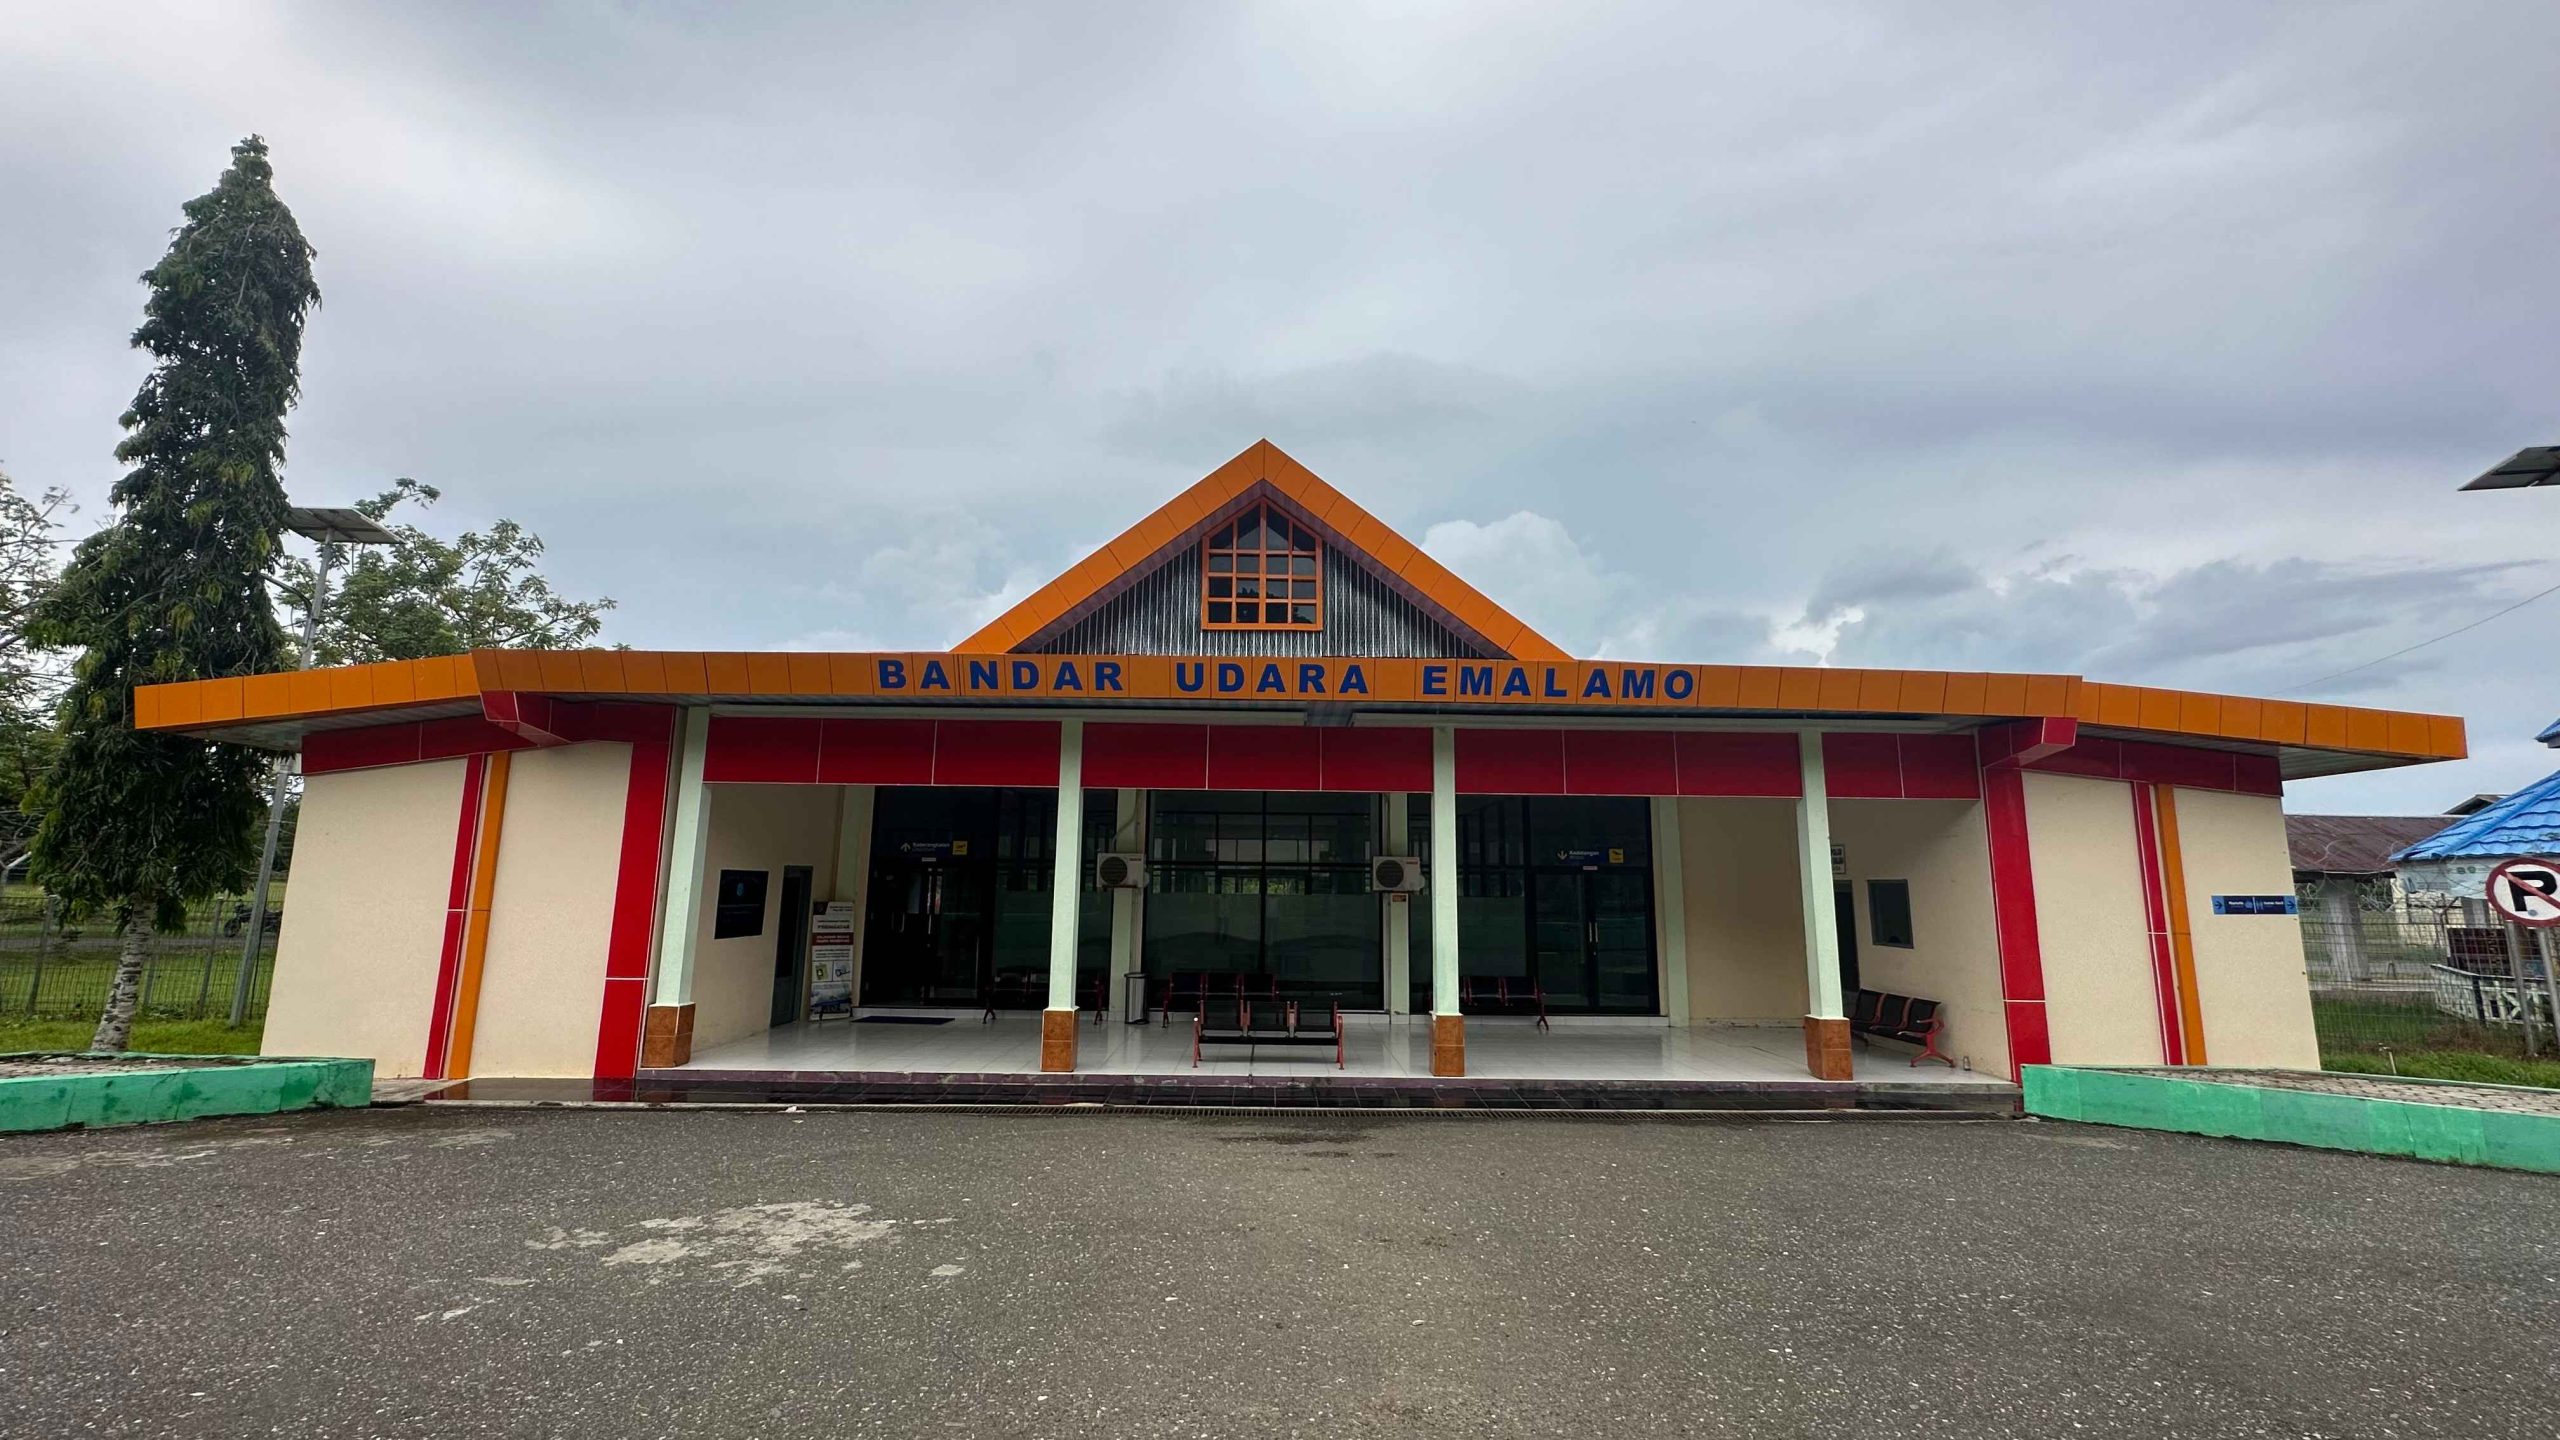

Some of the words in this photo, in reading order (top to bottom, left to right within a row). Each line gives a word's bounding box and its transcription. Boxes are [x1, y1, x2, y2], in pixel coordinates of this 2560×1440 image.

[879, 660, 1123, 690] BANDAR
[1176, 663, 1368, 694] UDARA
[1423, 666, 1694, 700] EMALAMO
[2506, 870, 2557, 912] P
